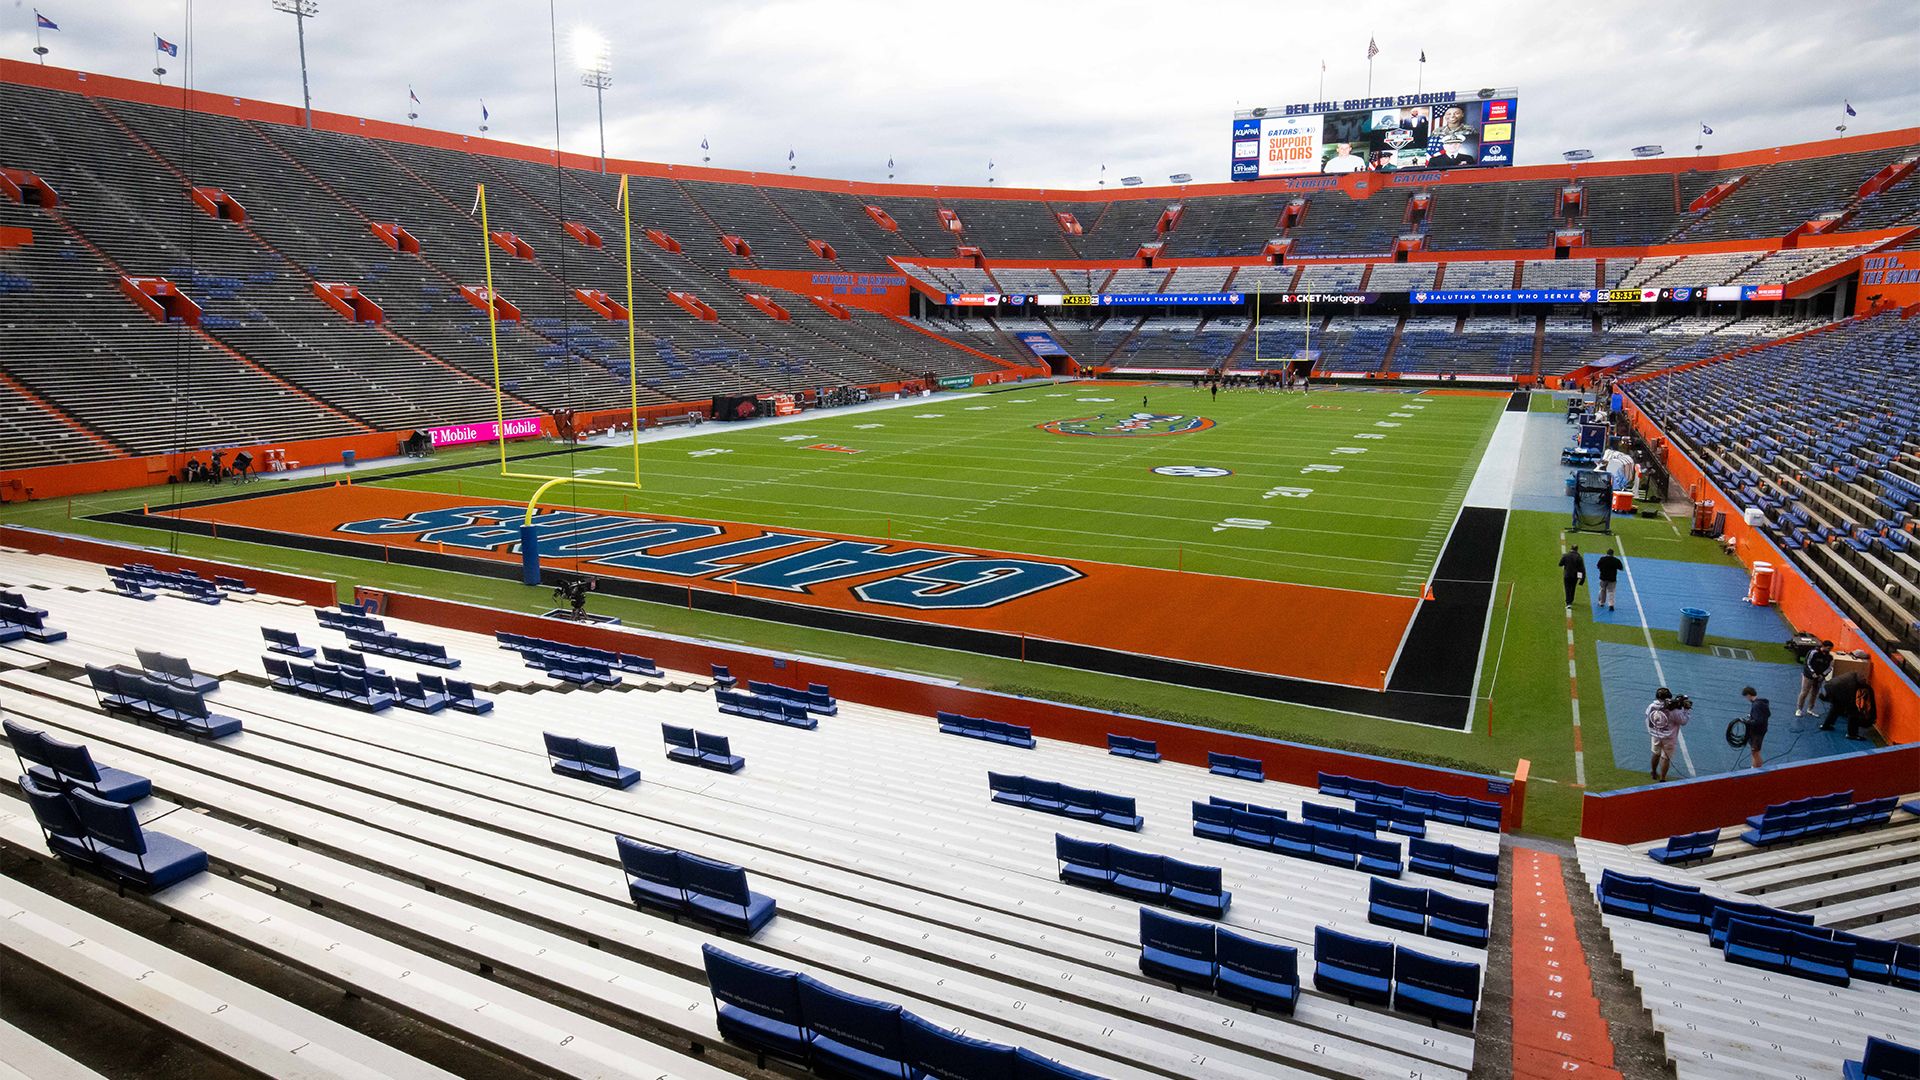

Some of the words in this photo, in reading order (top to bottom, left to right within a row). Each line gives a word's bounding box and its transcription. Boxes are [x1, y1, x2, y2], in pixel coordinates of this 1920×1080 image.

[1286, 104, 1309, 115] BEN
[1313, 101, 1339, 112] HILL
[1343, 97, 1393, 110] GRIFFIN
[1397, 91, 1456, 106] STADIUM
[1268, 128, 1298, 137] GATORS
[1269, 136, 1313, 149] SUPPORT
[1269, 147, 1313, 162] GATORS
[1481, 154, 1507, 162] Allstate
[1393, 173, 1442, 183] GATORS
[1861, 270, 1884, 285] THE
[1885, 269, 1920, 284] SWAM
[1282, 294, 1321, 303] ROCKET
[1322, 294, 1366, 305] Mortgage
[1610, 291, 1632, 300] 43:33
[334, 503, 1089, 611] GATORS
[1061, 973, 1073, 981] 10
[1549, 989, 1563, 998] 14
[1141, 995, 1150, 1003] 11
[688, 1002, 699, 1011] 8
[1013, 1001, 1026, 1010] 10
[1222, 1018, 1234, 1027] 12
[1102, 1027, 1114, 1036] 11
[560, 1036, 574, 1046] 8
[1314, 1044, 1325, 1054] 13
[1191, 1055, 1206, 1065] 12
[1562, 1061, 1580, 1072] 17
[1410, 1071, 1422, 1080] 14
